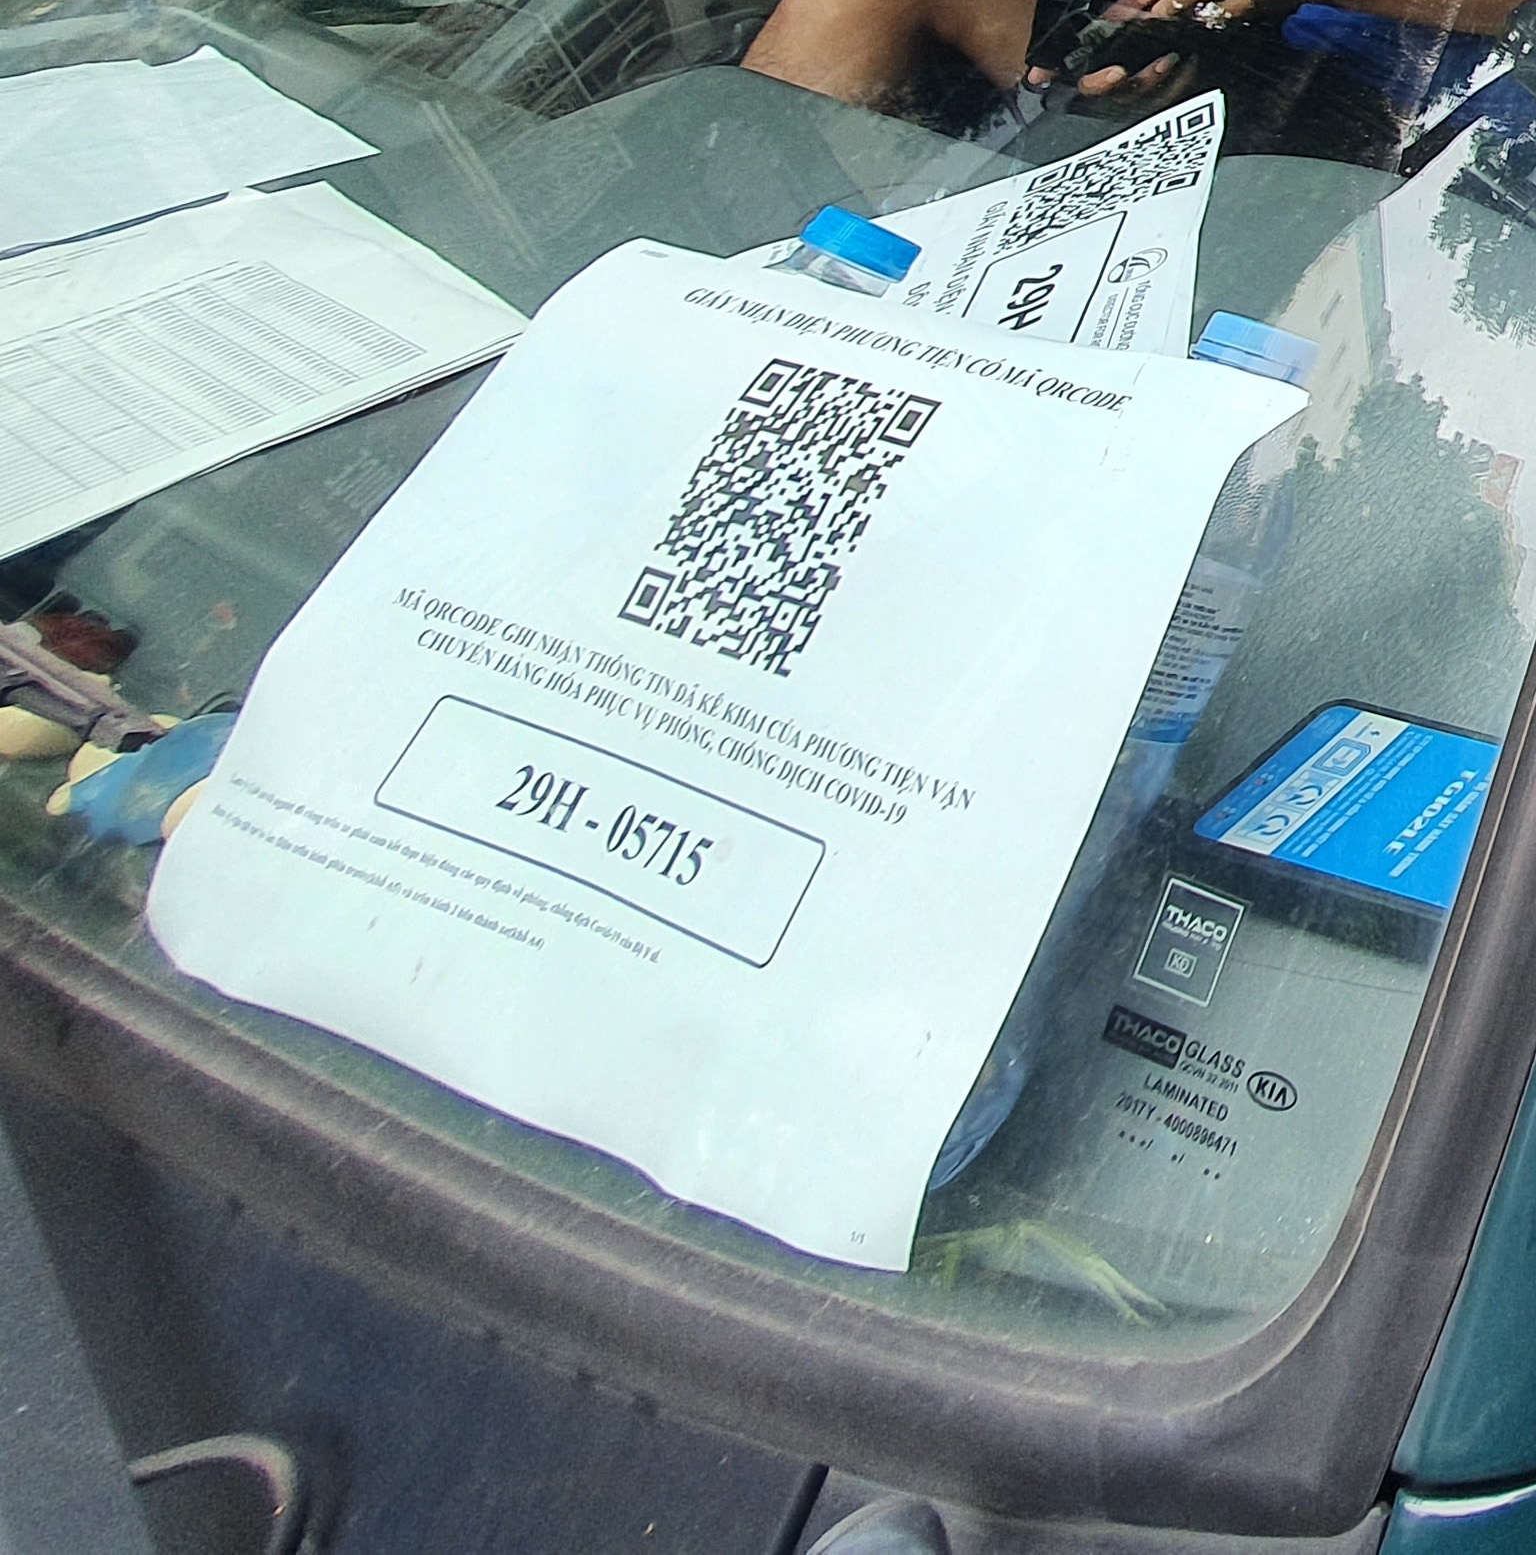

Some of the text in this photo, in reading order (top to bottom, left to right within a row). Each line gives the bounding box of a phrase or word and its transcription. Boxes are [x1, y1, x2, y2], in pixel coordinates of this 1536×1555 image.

[997, 264, 1064, 330] 29H
[684, 288, 736, 311] GIẤY
[729, 299, 787, 324] NHẬN
[918, 345, 971, 369] TIỆN
[966, 358, 1007, 378] CÓ
[996, 366, 1043, 388] MÃ
[1036, 376, 1132, 412] QRCODE
[423, 597, 503, 637] QRCODE
[501, 622, 541, 648] GHI
[644, 671, 677, 698] TIN
[721, 701, 768, 735] KHAI
[495, 764, 715, 886] 29H - 05715
[777, 759, 826, 790] DỊCH
[823, 778, 909, 825] COVID-19
[1166, 905, 1228, 942] THACO
[1114, 1014, 1247, 1079] THACO GLASS
[1144, 1074, 1229, 1122] LAMINATED
[1255, 1077, 1289, 1106] KIA
